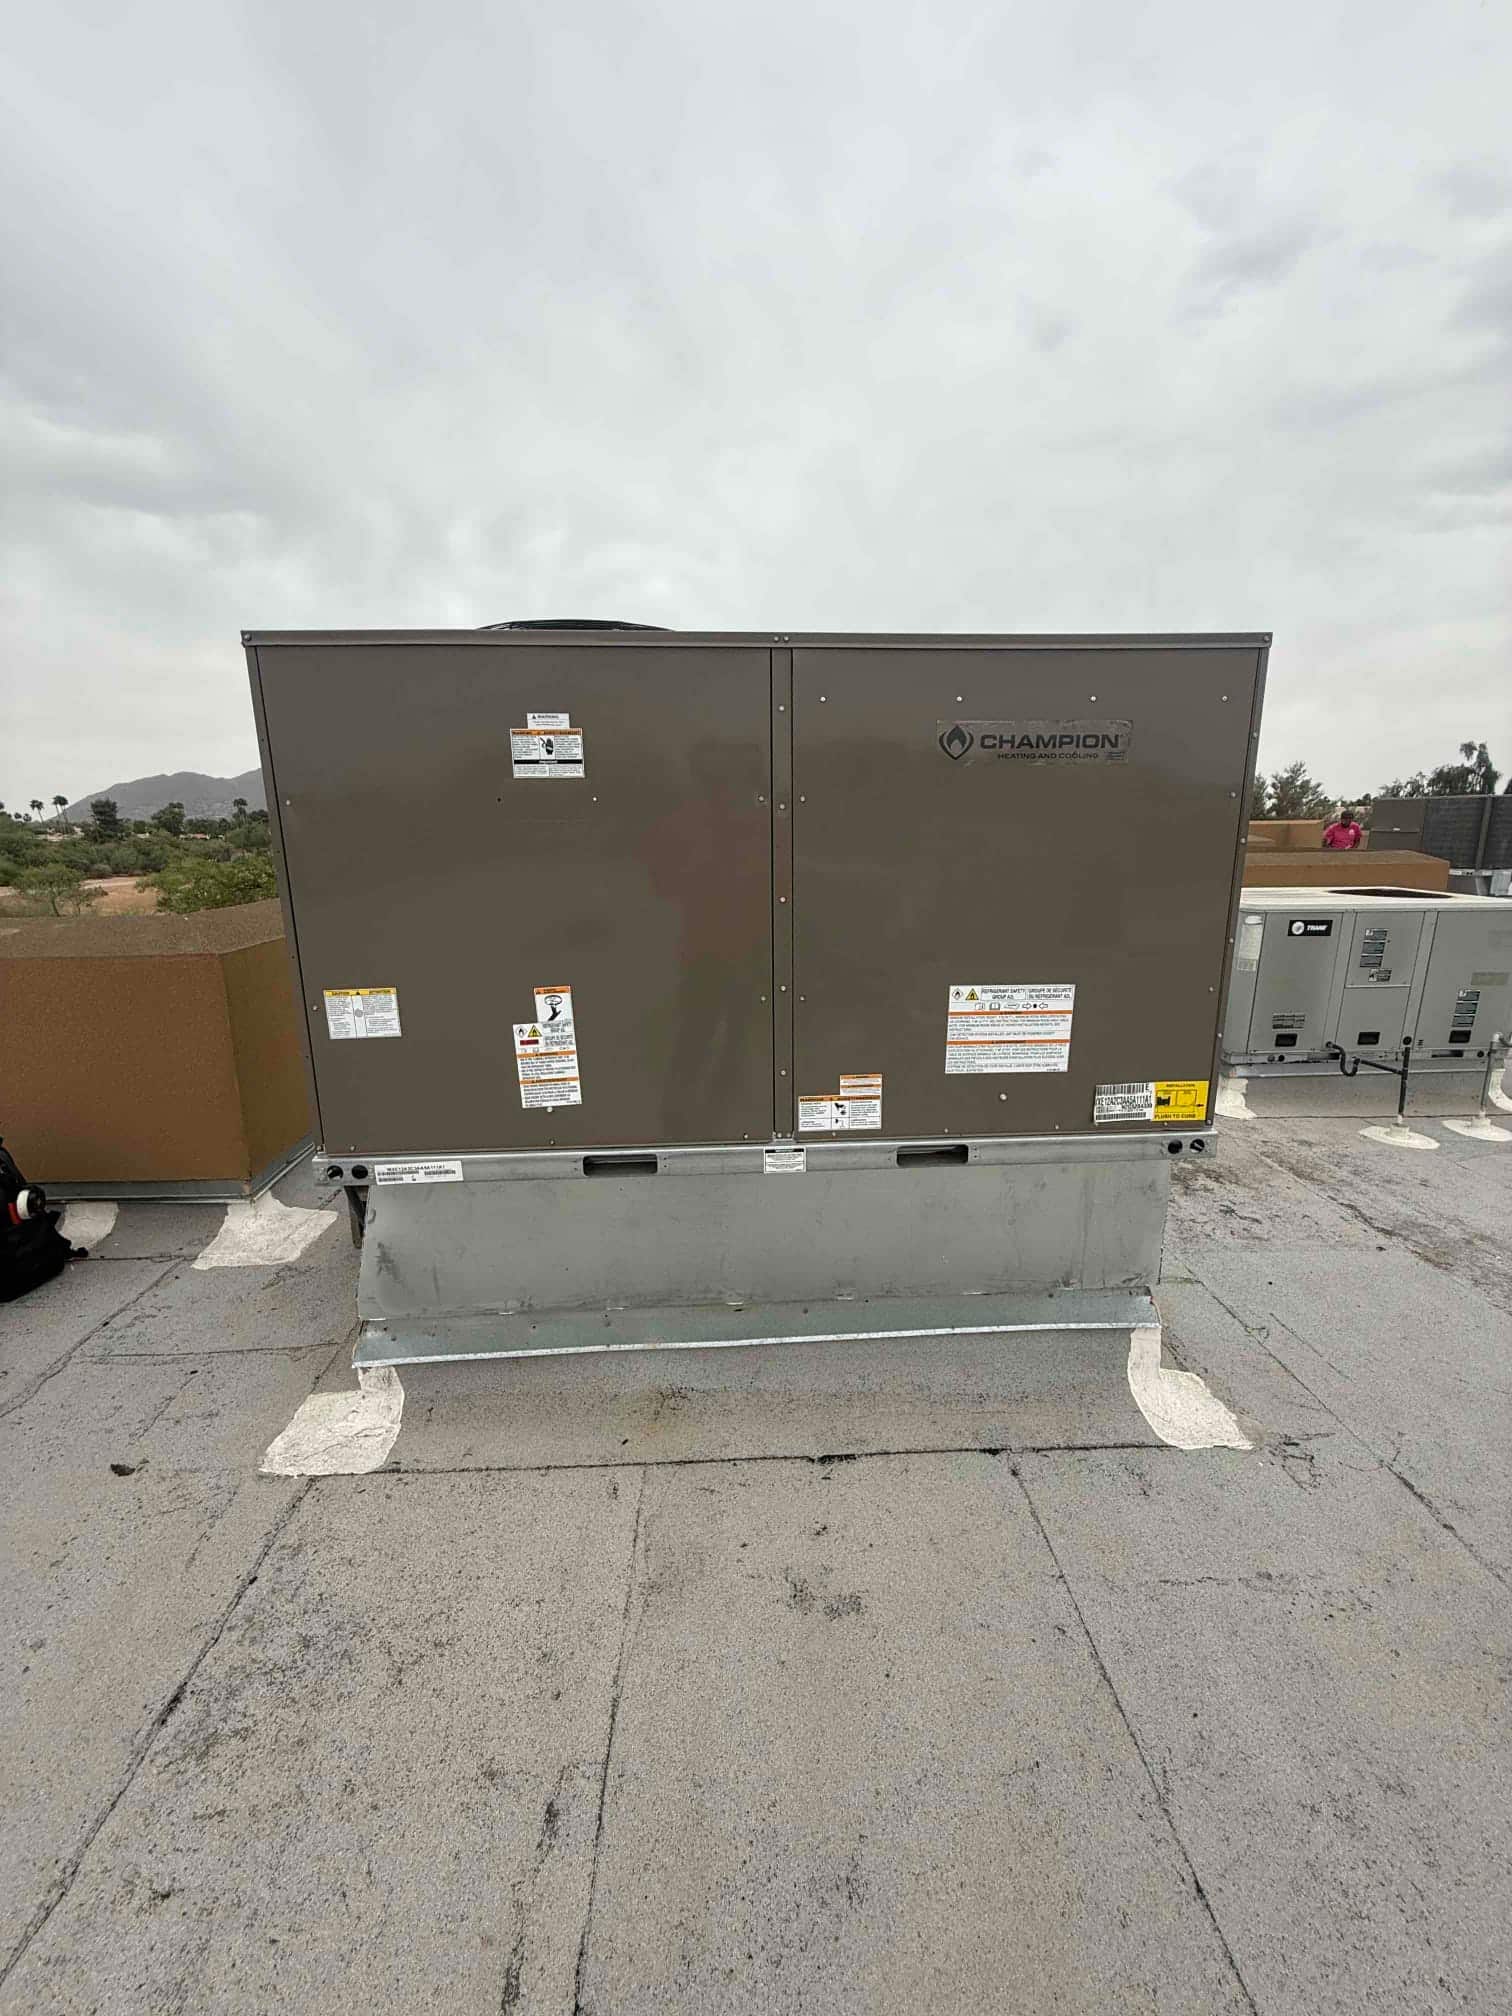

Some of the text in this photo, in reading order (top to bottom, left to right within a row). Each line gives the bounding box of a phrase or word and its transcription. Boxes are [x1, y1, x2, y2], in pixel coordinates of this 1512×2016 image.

[980, 734, 1119, 750] CHAMPION
[998, 752, 1036, 760] HEATING
[1037, 752, 1057, 760] AND
[1058, 752, 1099, 760] COOLING
